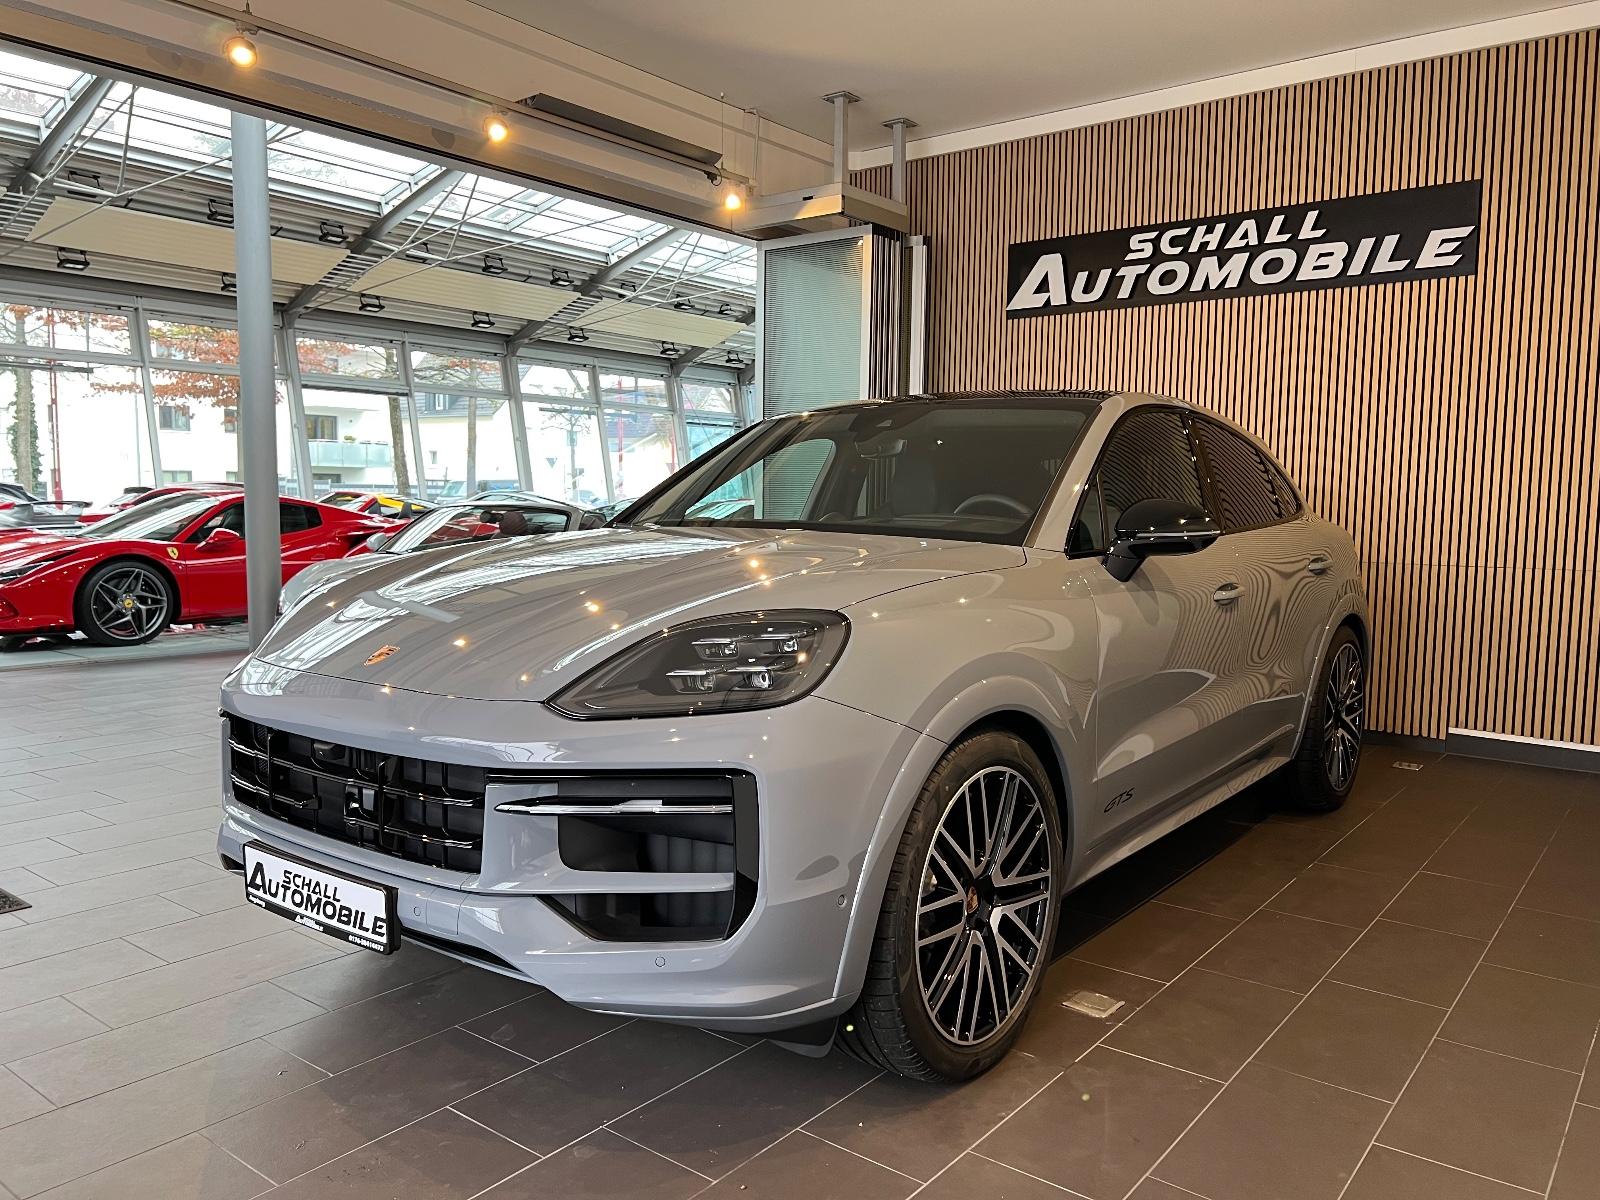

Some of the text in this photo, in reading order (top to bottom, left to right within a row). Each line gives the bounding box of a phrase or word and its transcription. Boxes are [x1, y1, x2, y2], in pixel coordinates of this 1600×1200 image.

[1123, 209, 1331, 261] SCHALL
[1006, 225, 1476, 312] AUTOMOBILE
[1103, 786, 1136, 814] GTS
[248, 861, 388, 938] AUTOMOBILE
[281, 869, 341, 902] SCHALL
